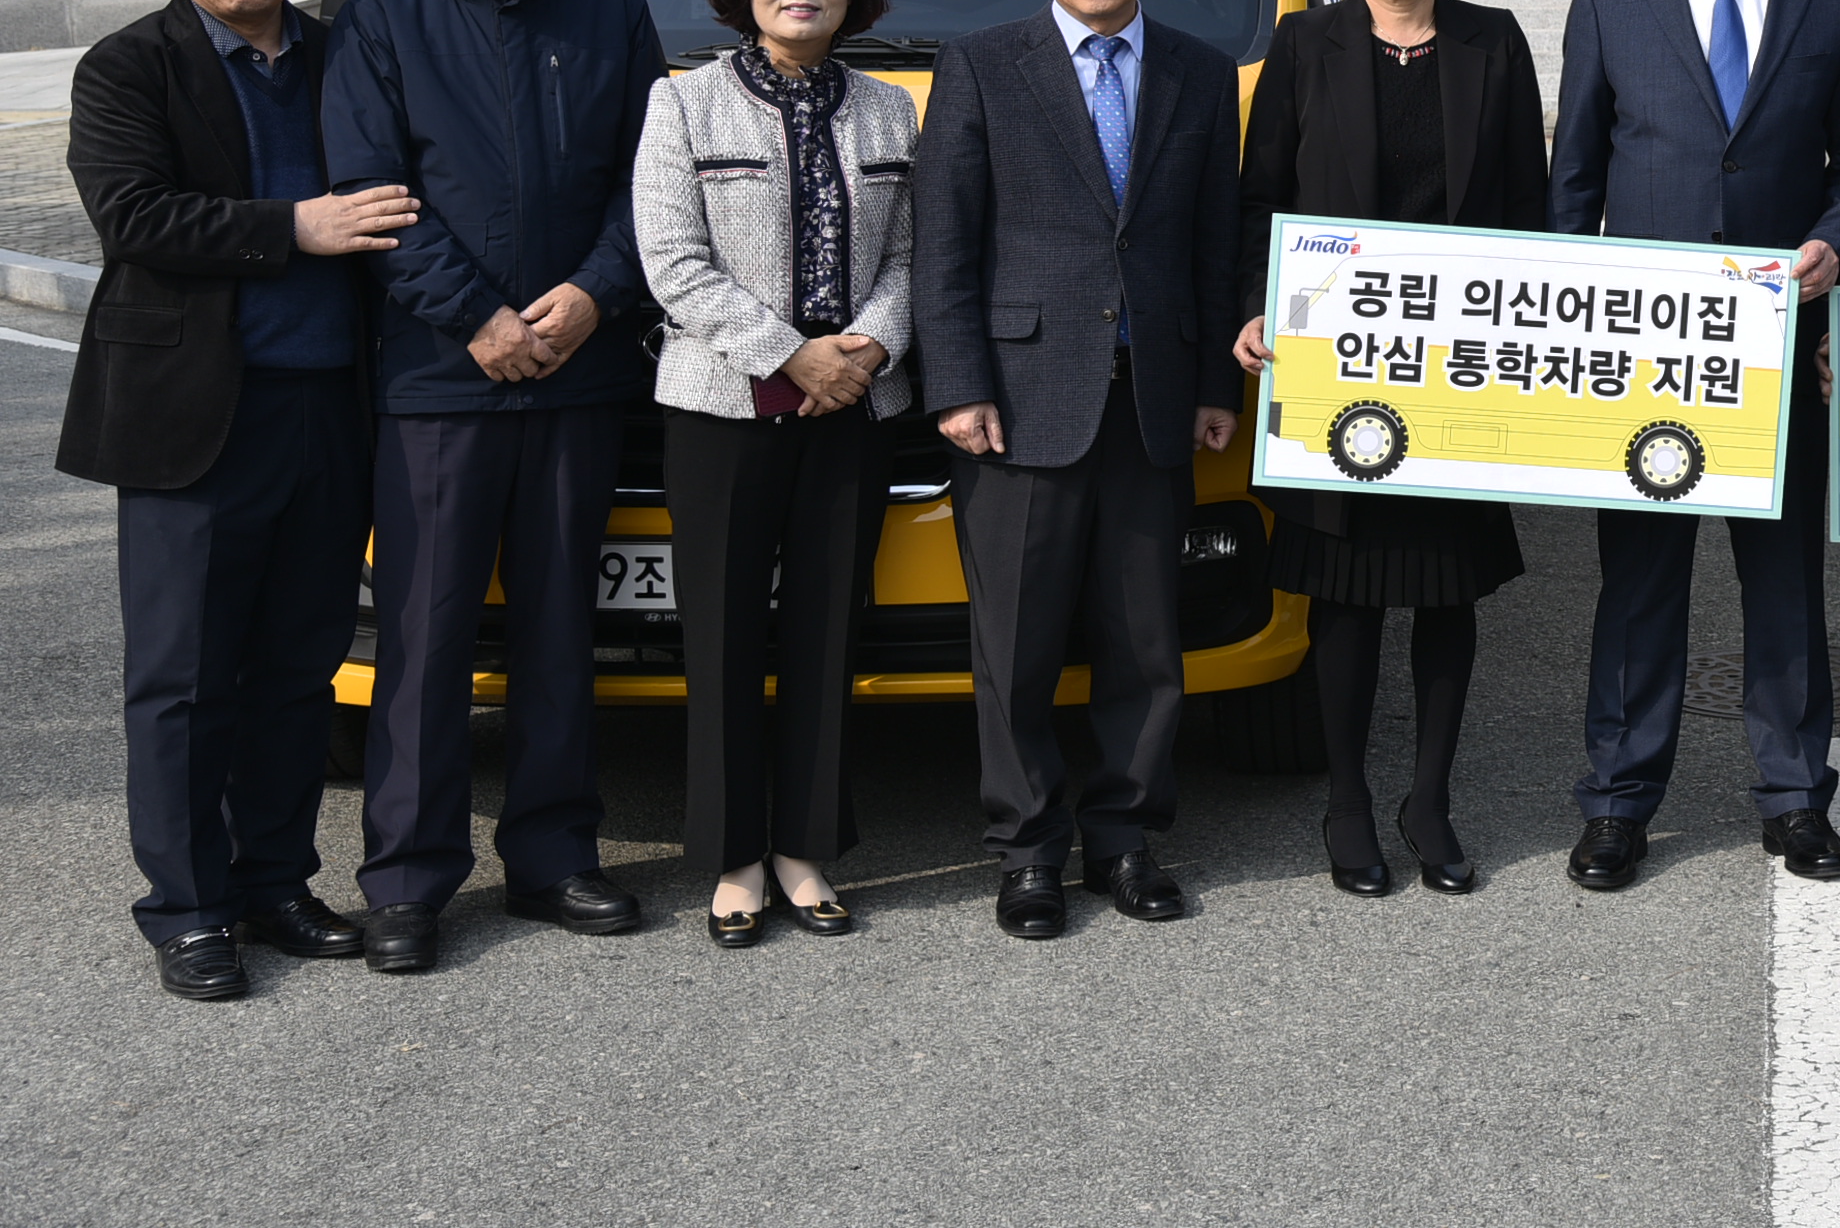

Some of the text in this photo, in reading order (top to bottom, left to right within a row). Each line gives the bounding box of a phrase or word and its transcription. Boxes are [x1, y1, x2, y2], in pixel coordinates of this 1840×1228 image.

[1289, 235, 1349, 254] Jindo
[1349, 271, 1738, 342] 공립 의신어린이집
[1336, 331, 1741, 404] 안심 통학차량 지원
